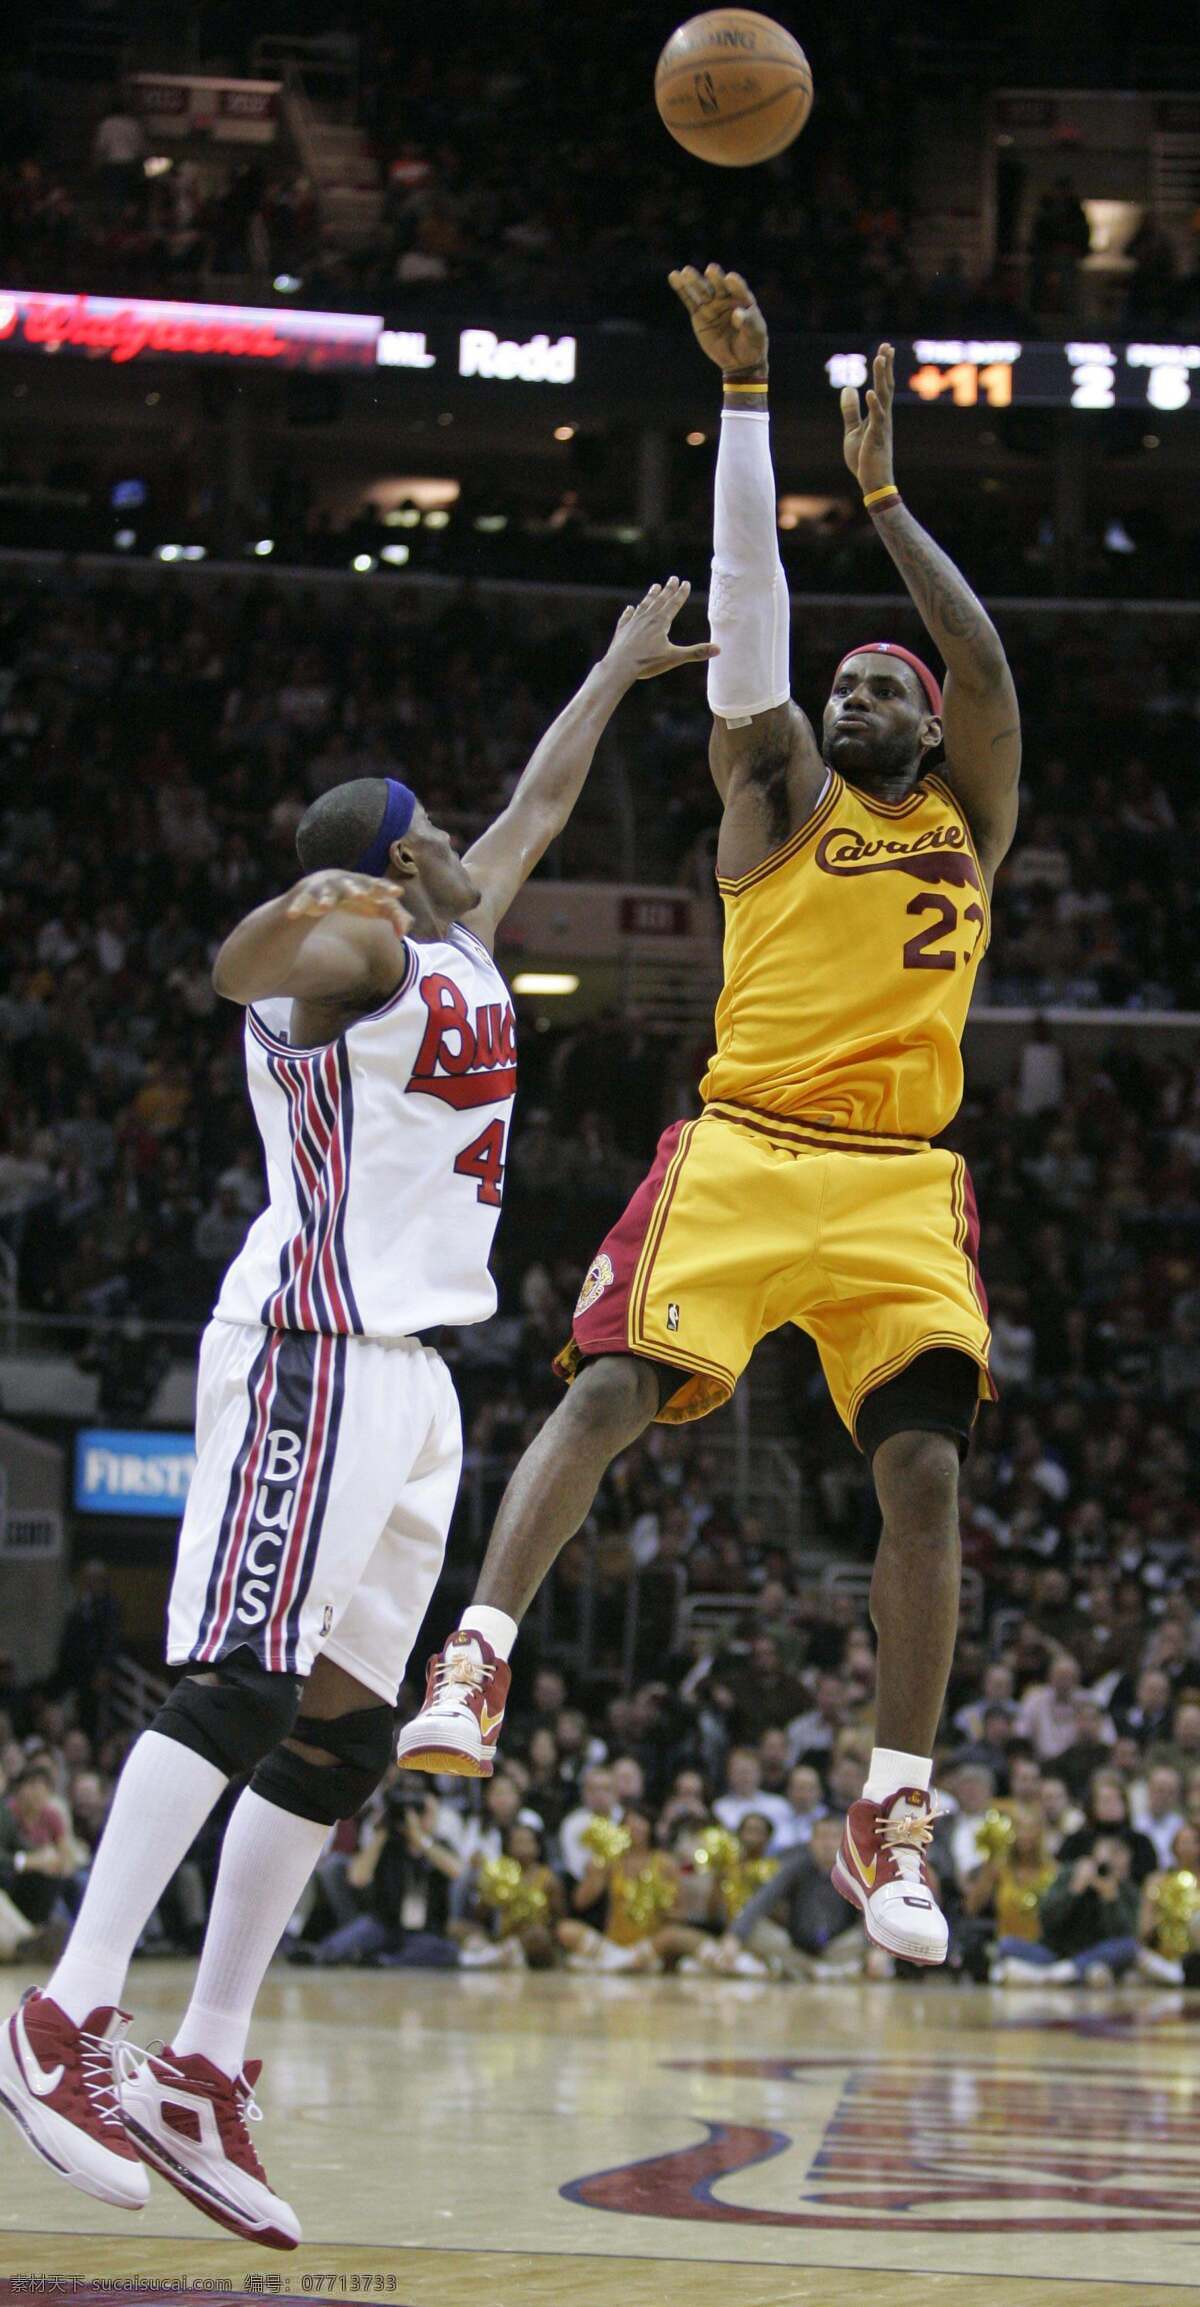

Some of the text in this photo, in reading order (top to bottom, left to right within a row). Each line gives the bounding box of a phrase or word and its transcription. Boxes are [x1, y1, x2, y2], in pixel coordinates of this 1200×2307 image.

[459, 329, 576, 384] Redd
[1071, 364, 1115, 409] 2
[815, 826, 967, 877] Cavalie
[411, 972, 518, 1077] Buc
[84, 1447, 196, 1497] FIRST
